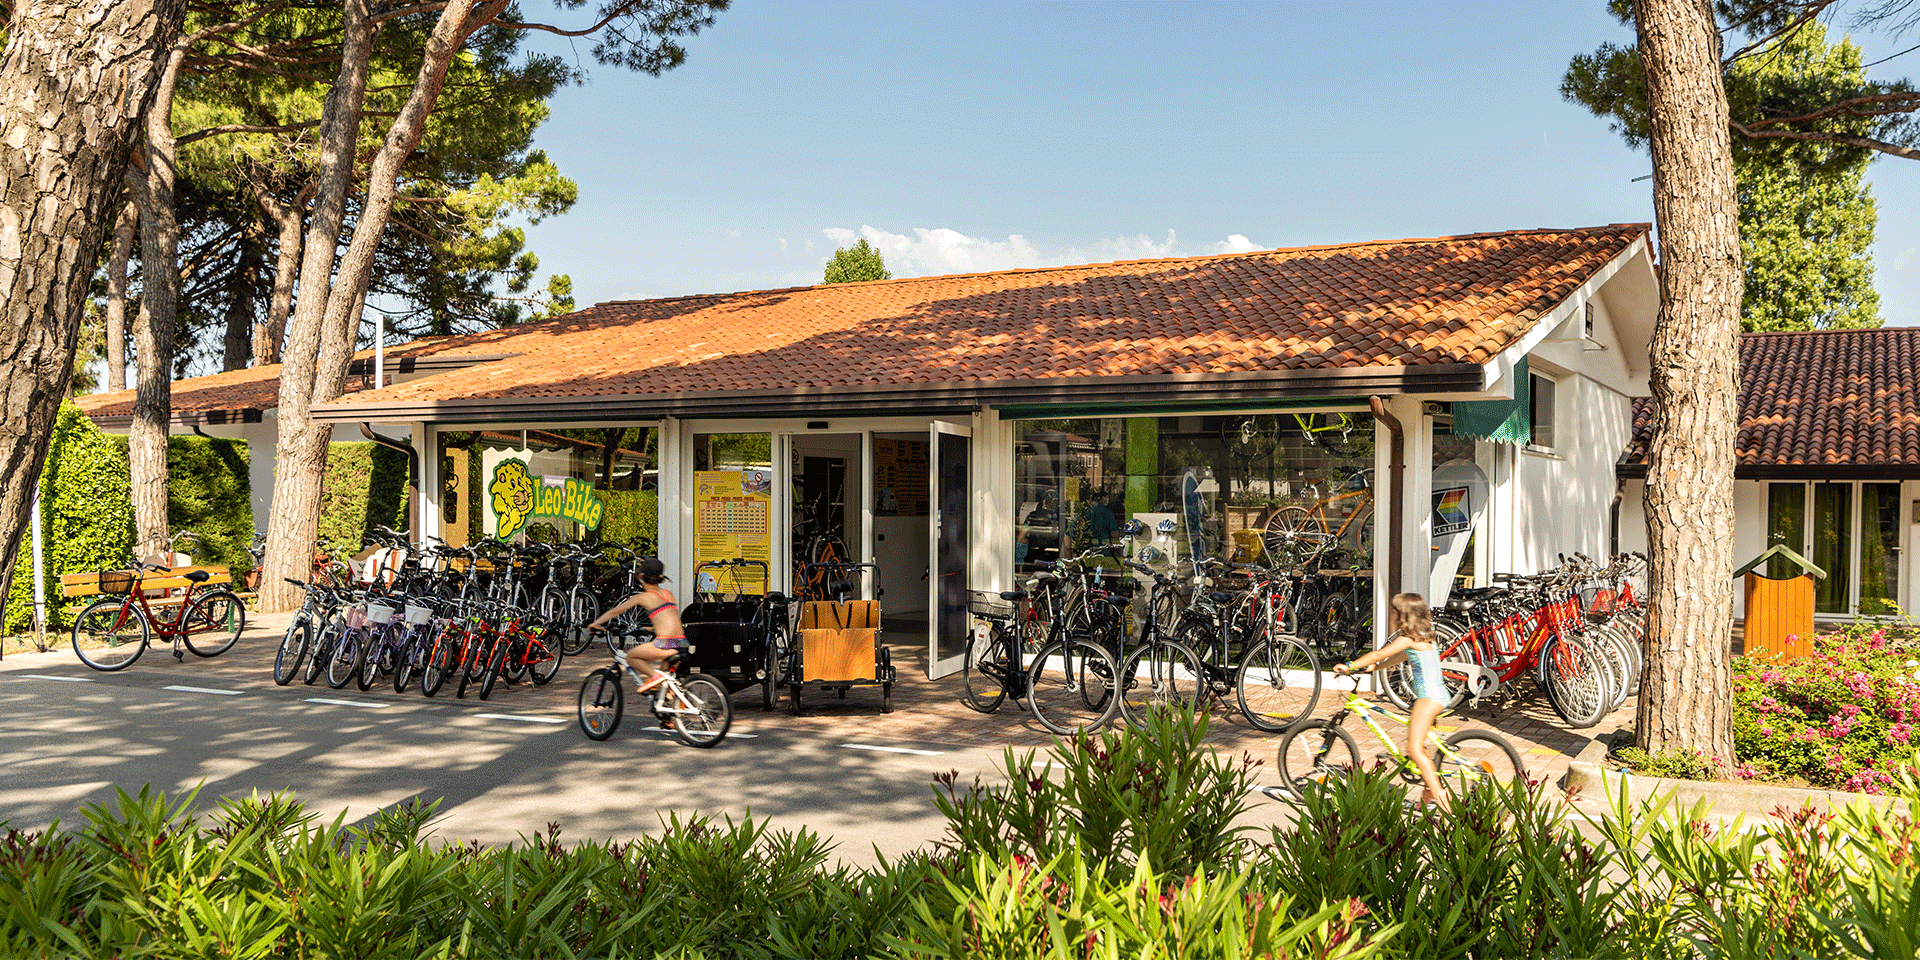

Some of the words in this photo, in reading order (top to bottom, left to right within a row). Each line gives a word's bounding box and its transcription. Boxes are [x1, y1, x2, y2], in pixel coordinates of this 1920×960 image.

[534, 479, 561, 515] Leo
[564, 480, 600, 527] Bike
[1434, 522, 1468, 534] KETTLER
